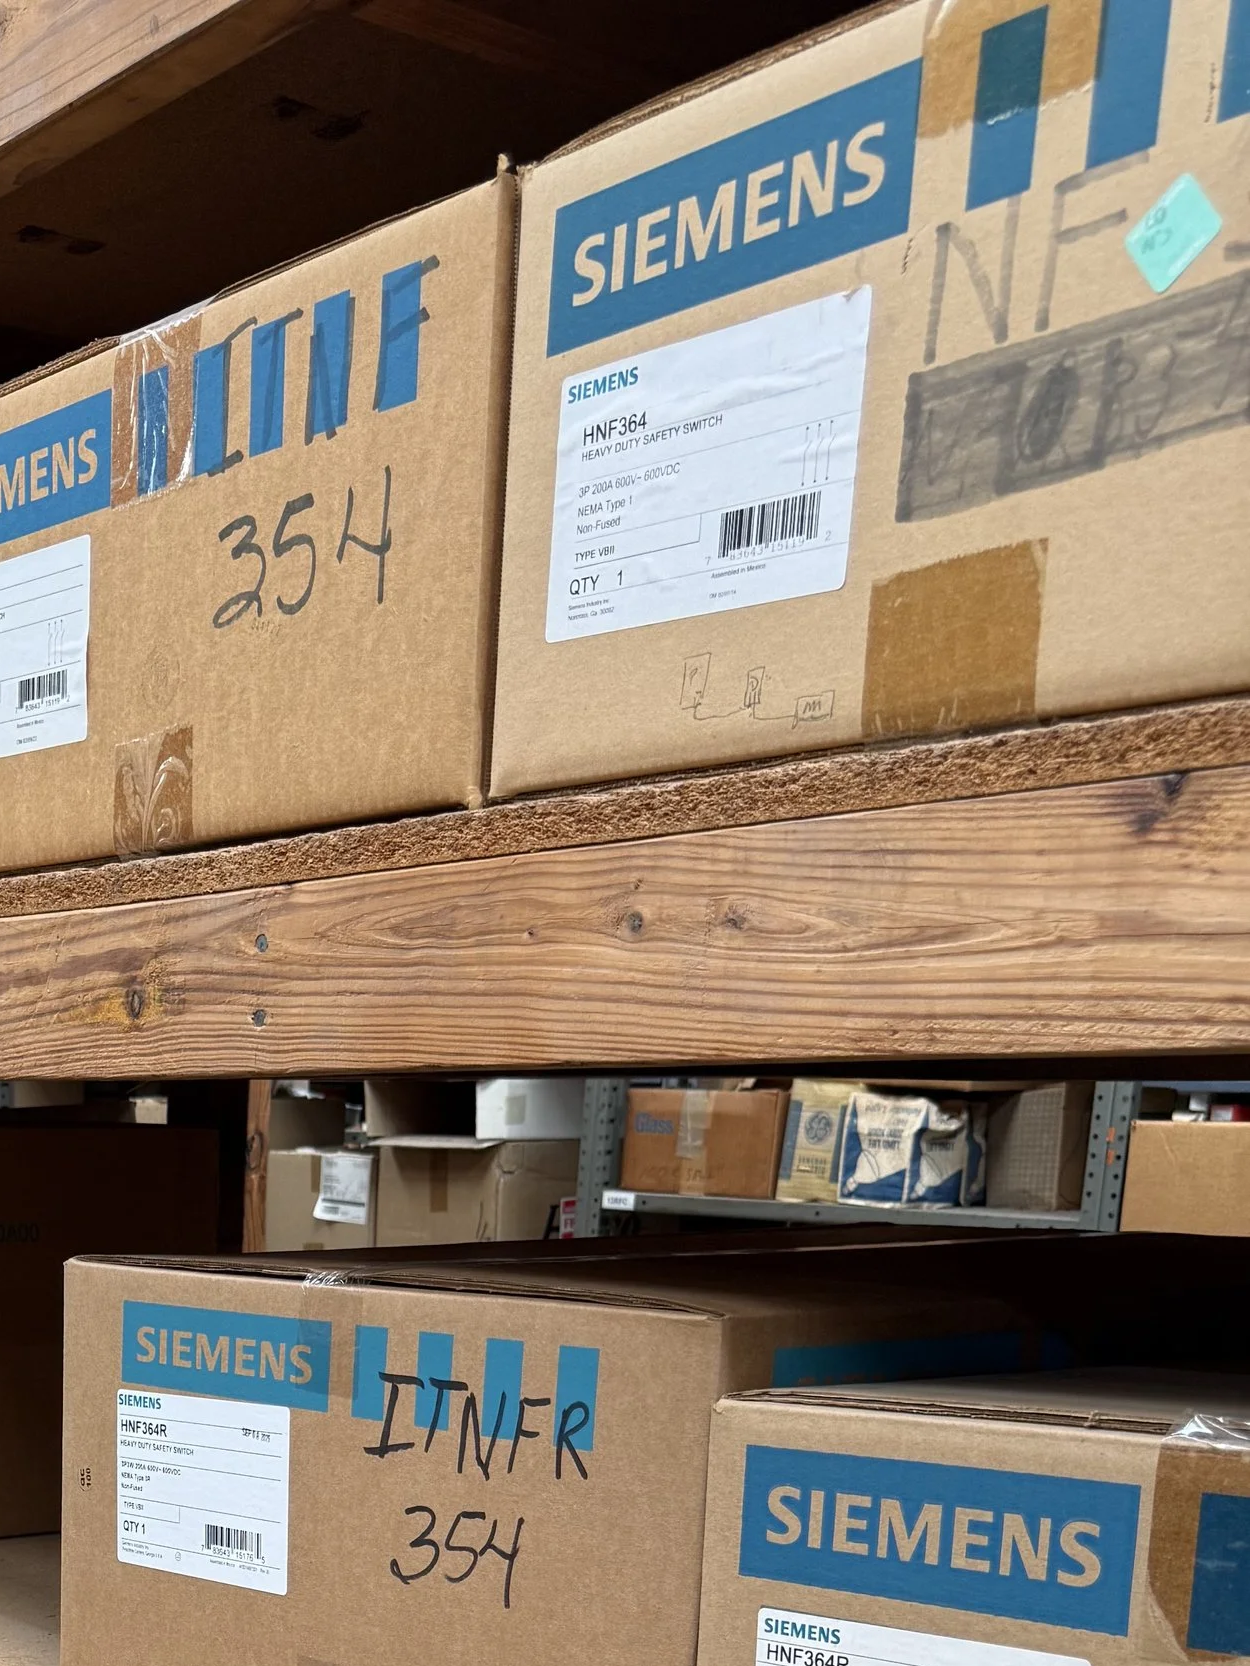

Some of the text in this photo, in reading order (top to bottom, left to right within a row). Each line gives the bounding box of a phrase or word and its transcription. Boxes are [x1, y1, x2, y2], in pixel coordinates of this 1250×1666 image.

[571, 122, 886, 307] SIEMENS
[567, 366, 639, 404] SIEMENS
[581, 414, 724, 462] HEAVY DUTY SAFETY SWITCH
[582, 411, 648, 446] HNF364
[578, 485, 590, 498] 3P
[591, 480, 614, 496] 200A
[643, 462, 681, 481] 600VDC
[576, 515, 621, 535] Non-Fused
[577, 502, 603, 518] NEMA
[605, 498, 626, 513] Type
[212, 464, 393, 630] 354
[575, 548, 597, 563] TYPE
[569, 569, 624, 596] QTY 1
[136, 1325, 313, 1385] SIEMENS
[118, 1393, 162, 1410] SIEMENS
[120, 1419, 168, 1438] HNF364R
[363, 1371, 595, 1481] ITNFR
[137, 1441, 152, 1452] DUTY
[152, 1443, 172, 1454] SAFETY
[123, 1519, 146, 1535] QTY 1
[765, 1483, 1102, 1589] SIEMENS
[390, 1505, 525, 1609] 354
[764, 1617, 841, 1645] SIEMENS
